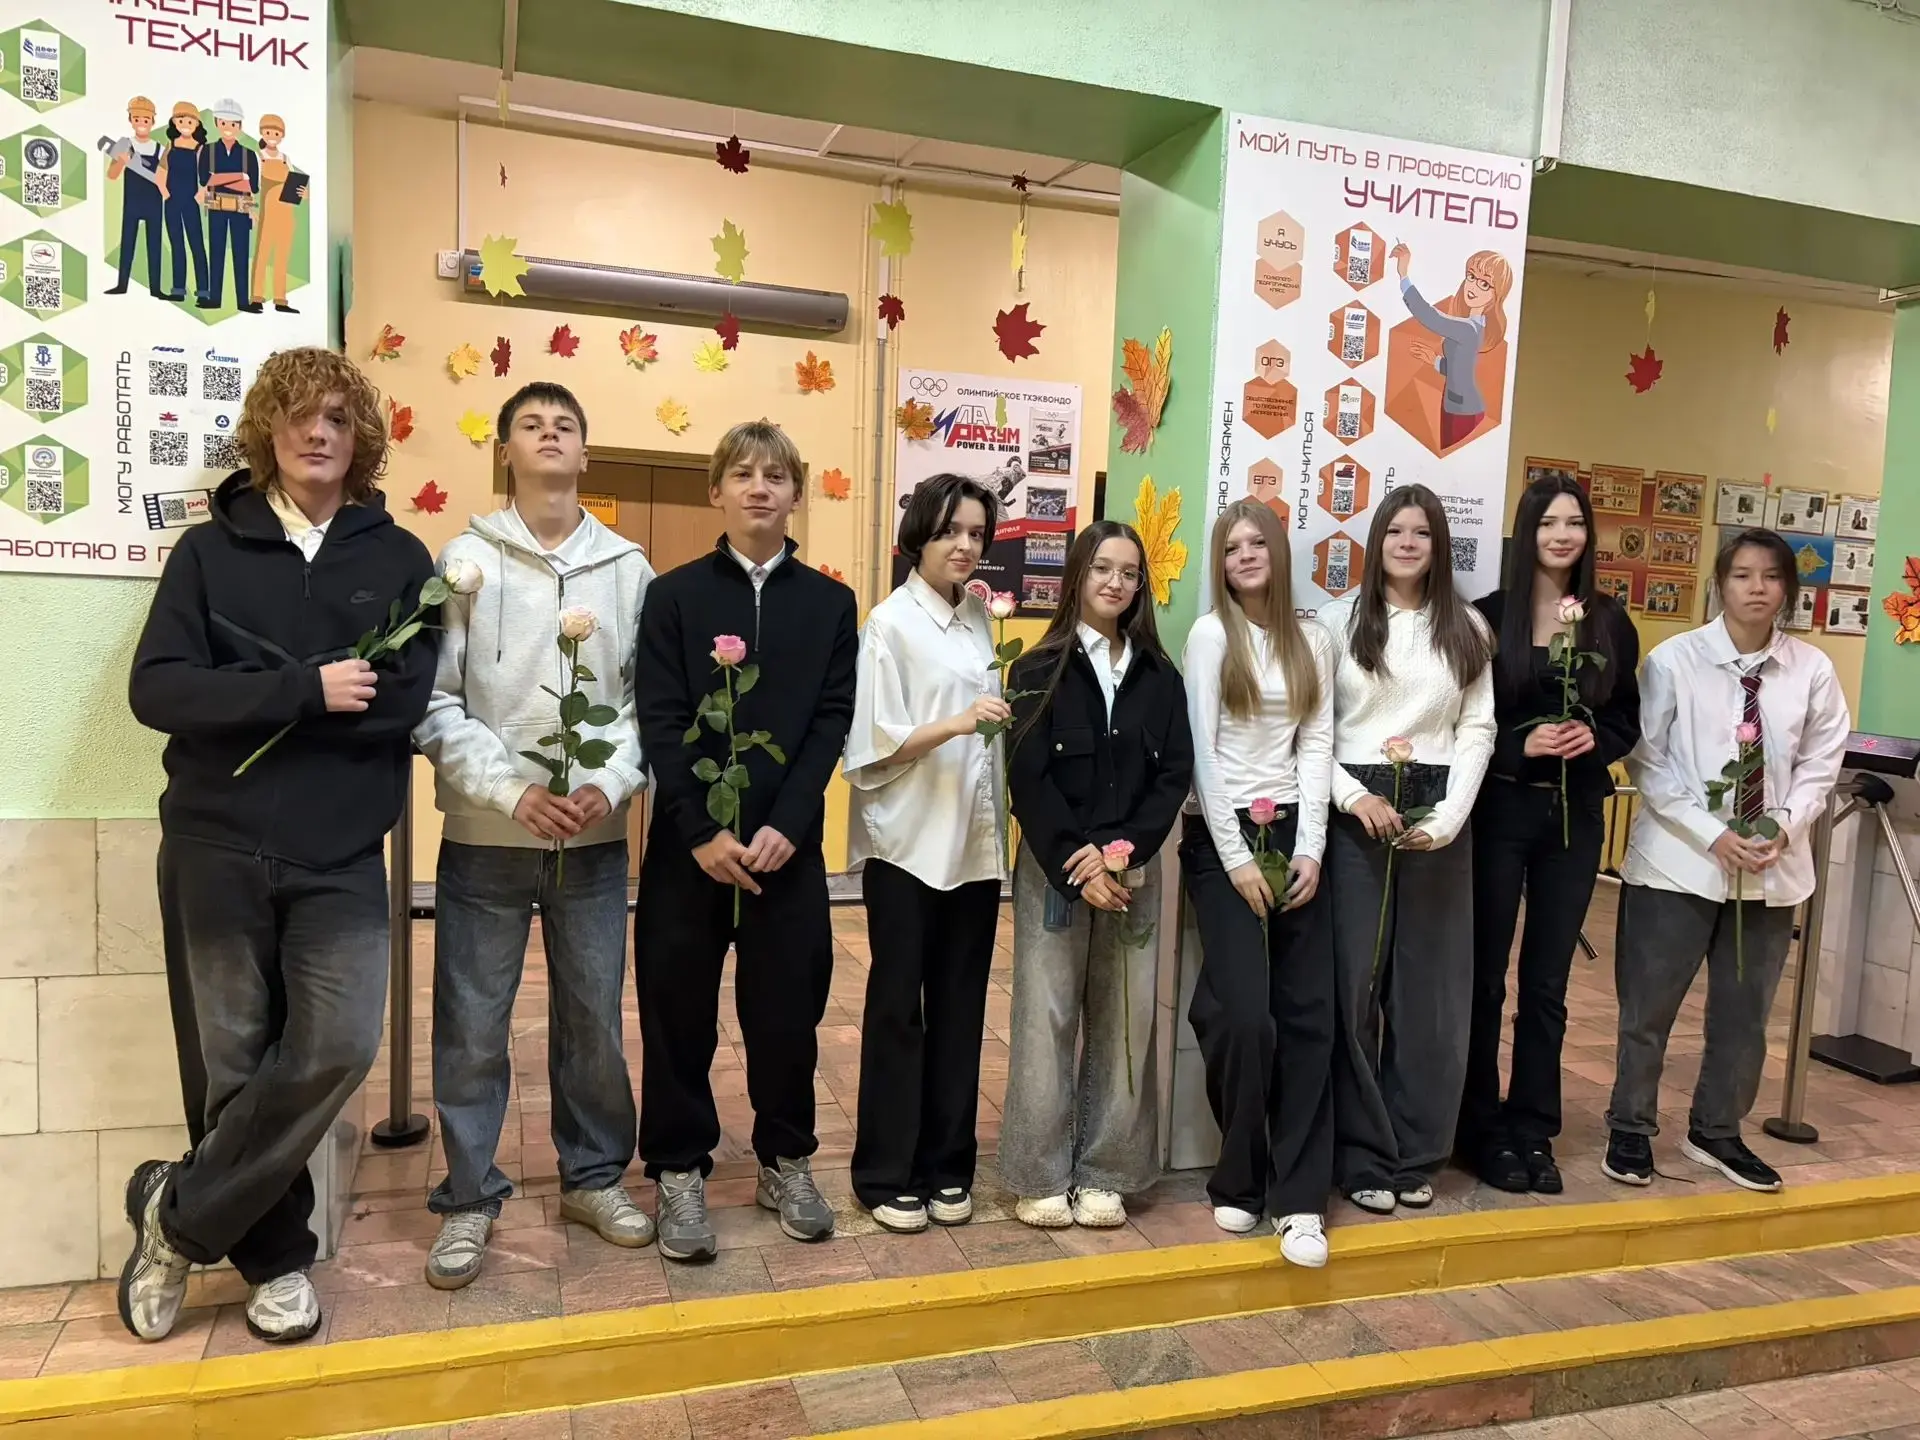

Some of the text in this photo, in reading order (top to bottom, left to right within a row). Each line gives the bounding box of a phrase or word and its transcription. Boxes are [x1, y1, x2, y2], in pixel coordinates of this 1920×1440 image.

[109, 0, 309, 26] ЕНЕР-
[115, 14, 309, 70] ТЕХНИК
[1239, 130, 1521, 190] МОЙ ПУТЬ В ПРОФЕССИЮ
[1344, 176, 1518, 230] УЧИТЕЛЬ
[1263, 238, 1297, 250] УЧУСЬ
[1277, 228, 1285, 236] Я
[1261, 356, 1285, 368] ОГЭ
[1023, 393, 1072, 405] ТХЭКВОНДО
[116, 350, 132, 514] МОГУ РАБОТАТЬ
[926, 403, 990, 441] ИЛА
[944, 423, 1021, 447] РАЗУМ
[956, 440, 1020, 453] POWER & MIND
[1217, 401, 1234, 516] ДАЮ ЭКЗАМЕН
[1297, 411, 1314, 529] МОГУ УЧИТЬСЯ
[1253, 475, 1277, 485] ЕГЭ
[1462, 517, 1483, 526] КРАЯ
[0, 539, 116, 560] АБОТАЮ
[128, 544, 146, 562] В
